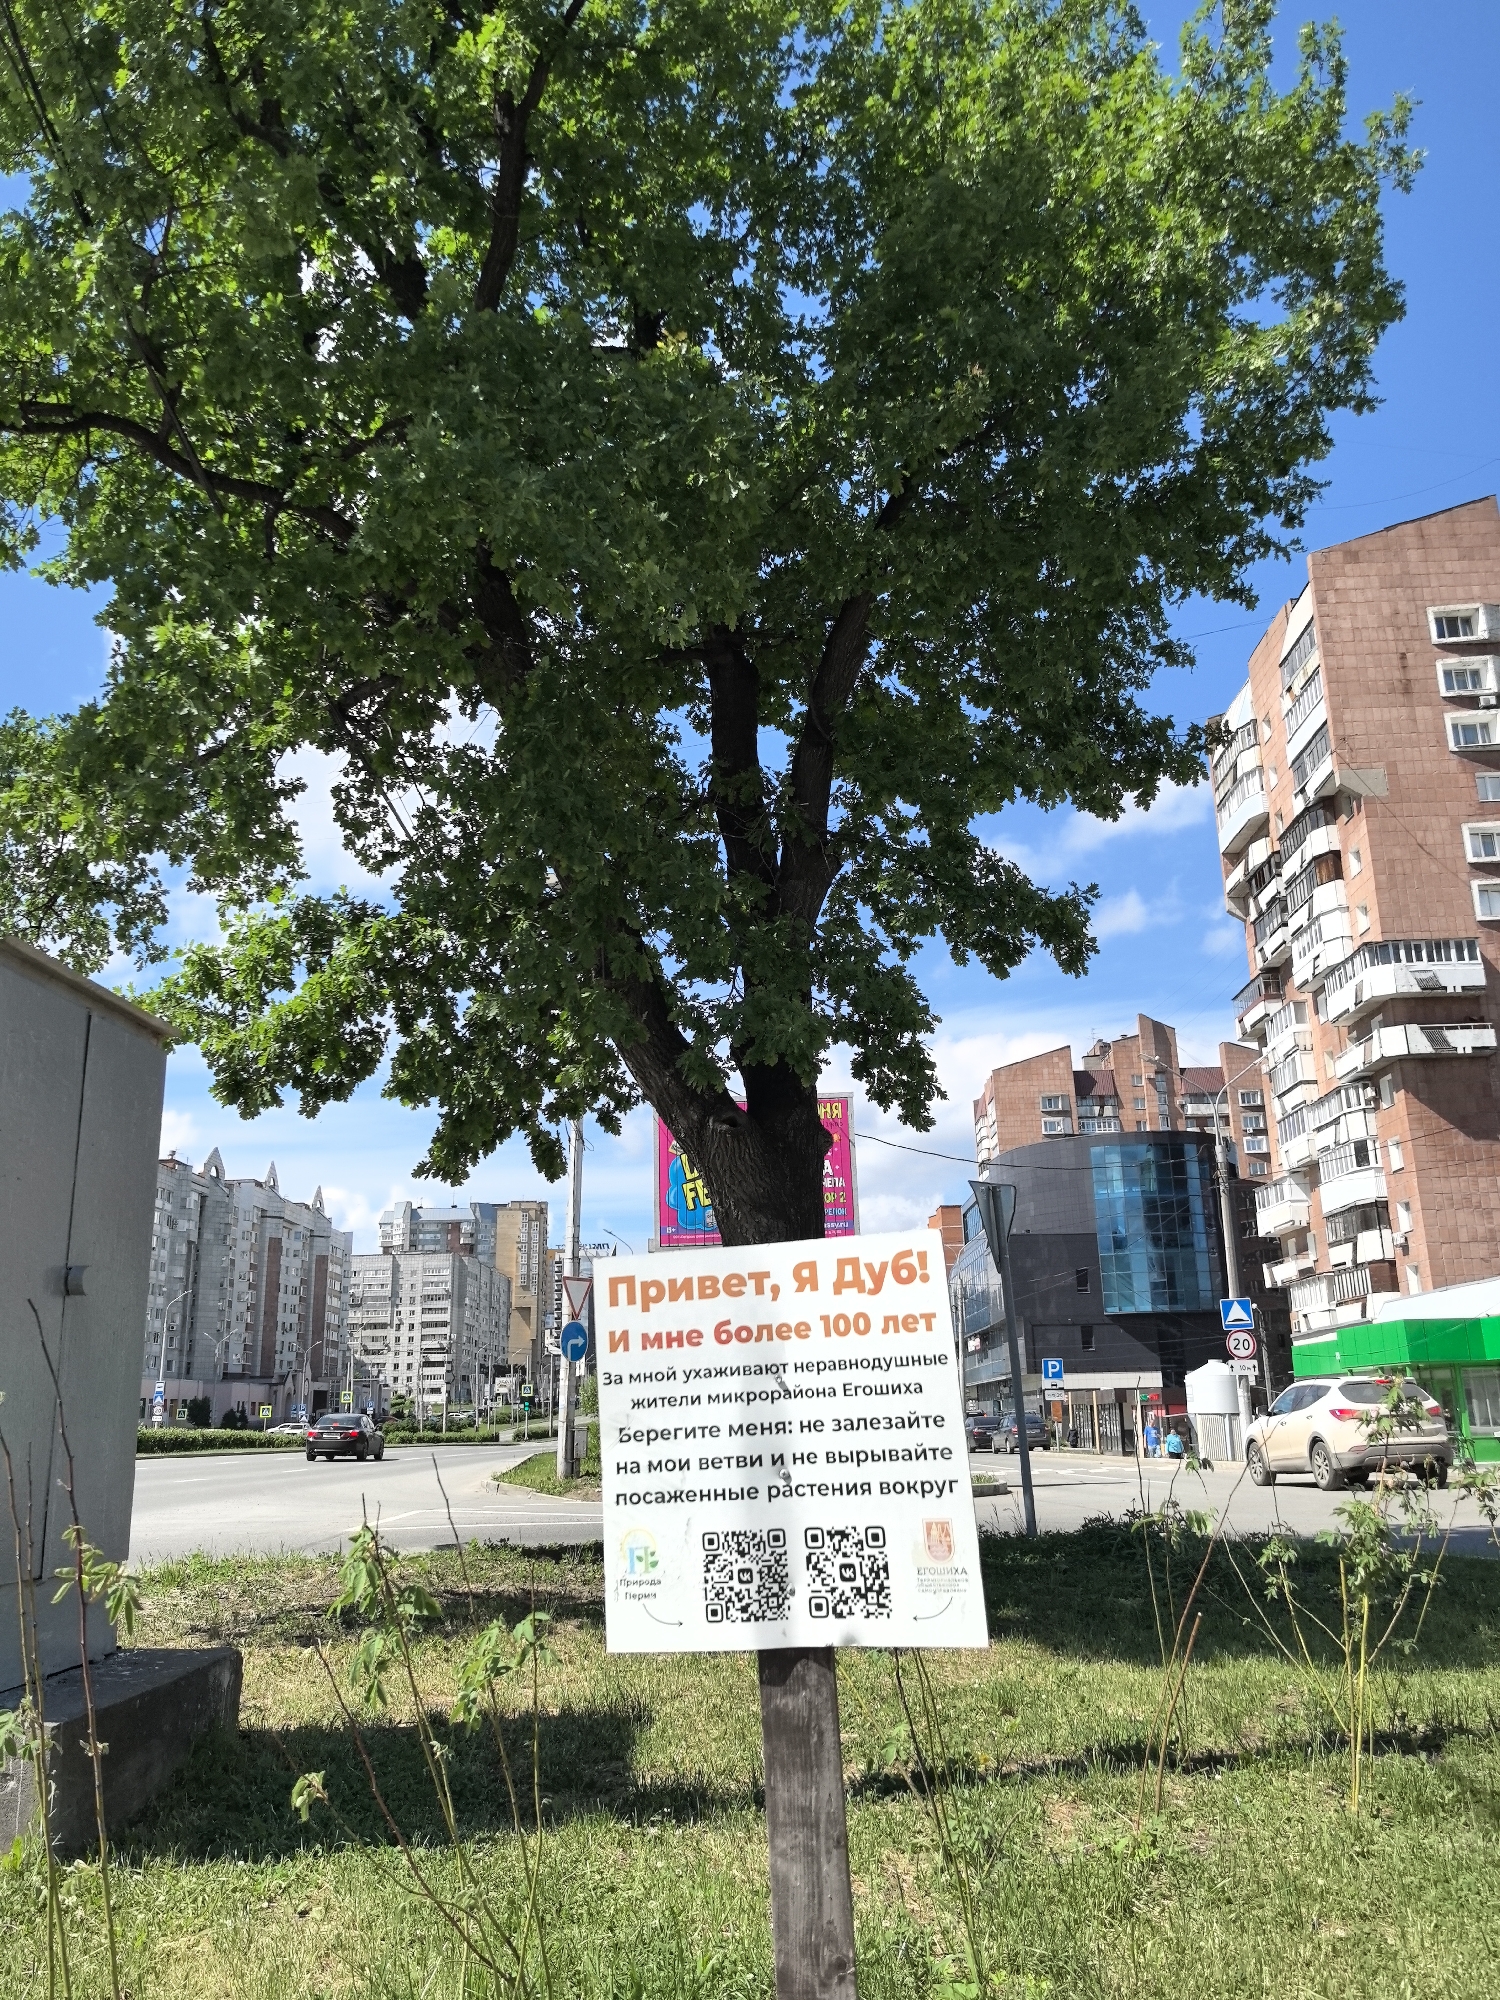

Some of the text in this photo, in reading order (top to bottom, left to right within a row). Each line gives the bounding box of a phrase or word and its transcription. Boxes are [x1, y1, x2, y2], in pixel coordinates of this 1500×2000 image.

[817, 1102, 842, 1119] НЯ
[609, 1250, 930, 1313] Привет, Я Дуб!
[609, 1312, 936, 1353] И мне более 100 лет
[1233, 1338, 1250, 1351] 20
[602, 1352, 949, 1387] За мной ухаживают неравнодушные
[630, 1381, 924, 1410] жители микрорайона Егошиха
[617, 1410, 946, 1446] Берегите меня: не залезайте
[616, 1443, 954, 1476] на мои ветви и не вырывайте
[615, 1478, 959, 1507] посаженные растения вокруг
[619, 1579, 662, 1587] Природа
[917, 1566, 968, 1575] ЕГОШИХА
[625, 1591, 657, 1601] Перми
